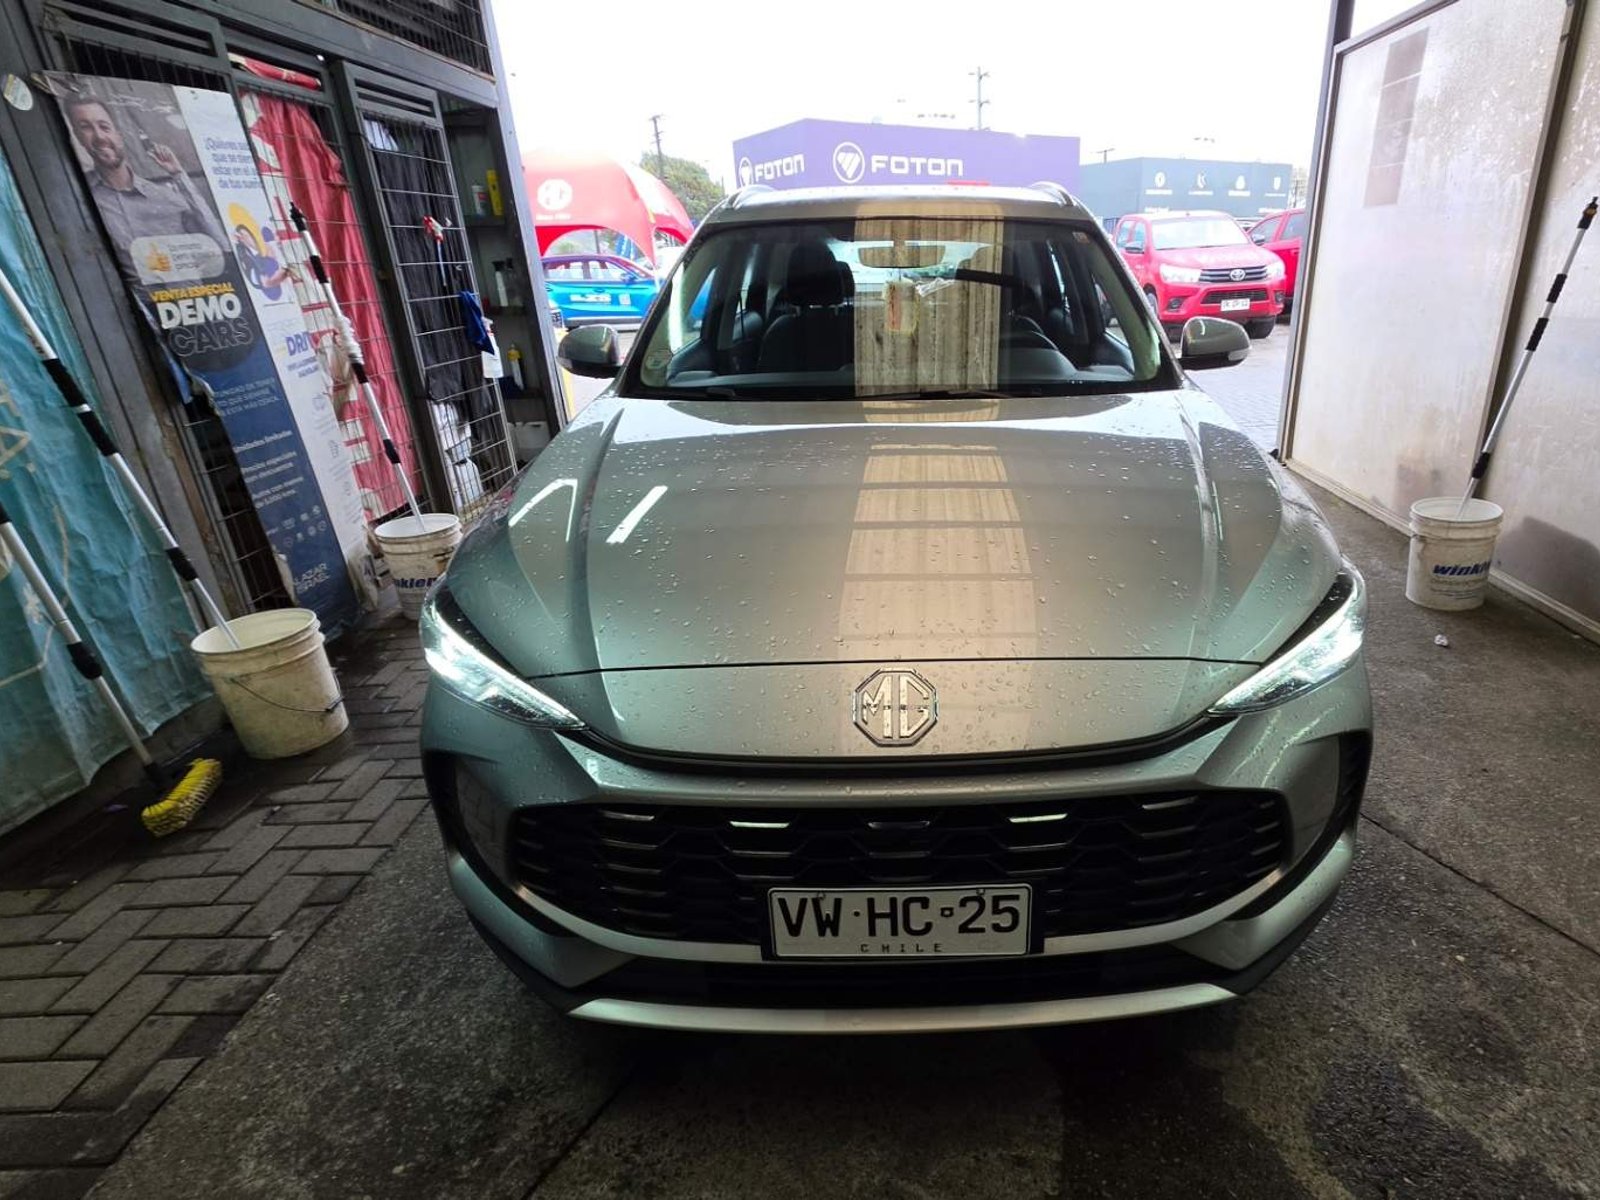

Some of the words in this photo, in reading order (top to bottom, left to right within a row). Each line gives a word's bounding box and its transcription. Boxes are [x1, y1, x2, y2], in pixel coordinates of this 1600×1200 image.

[755, 153, 805, 182] FOTON
[871, 154, 964, 177] FOTON
[149, 288, 188, 302] VENTA
[188, 281, 235, 298] ESPECIAL
[156, 293, 241, 329] DEMO
[169, 317, 254, 357] CARS
[861, 675, 930, 739] MG
[860, 943, 943, 953] CHILE
